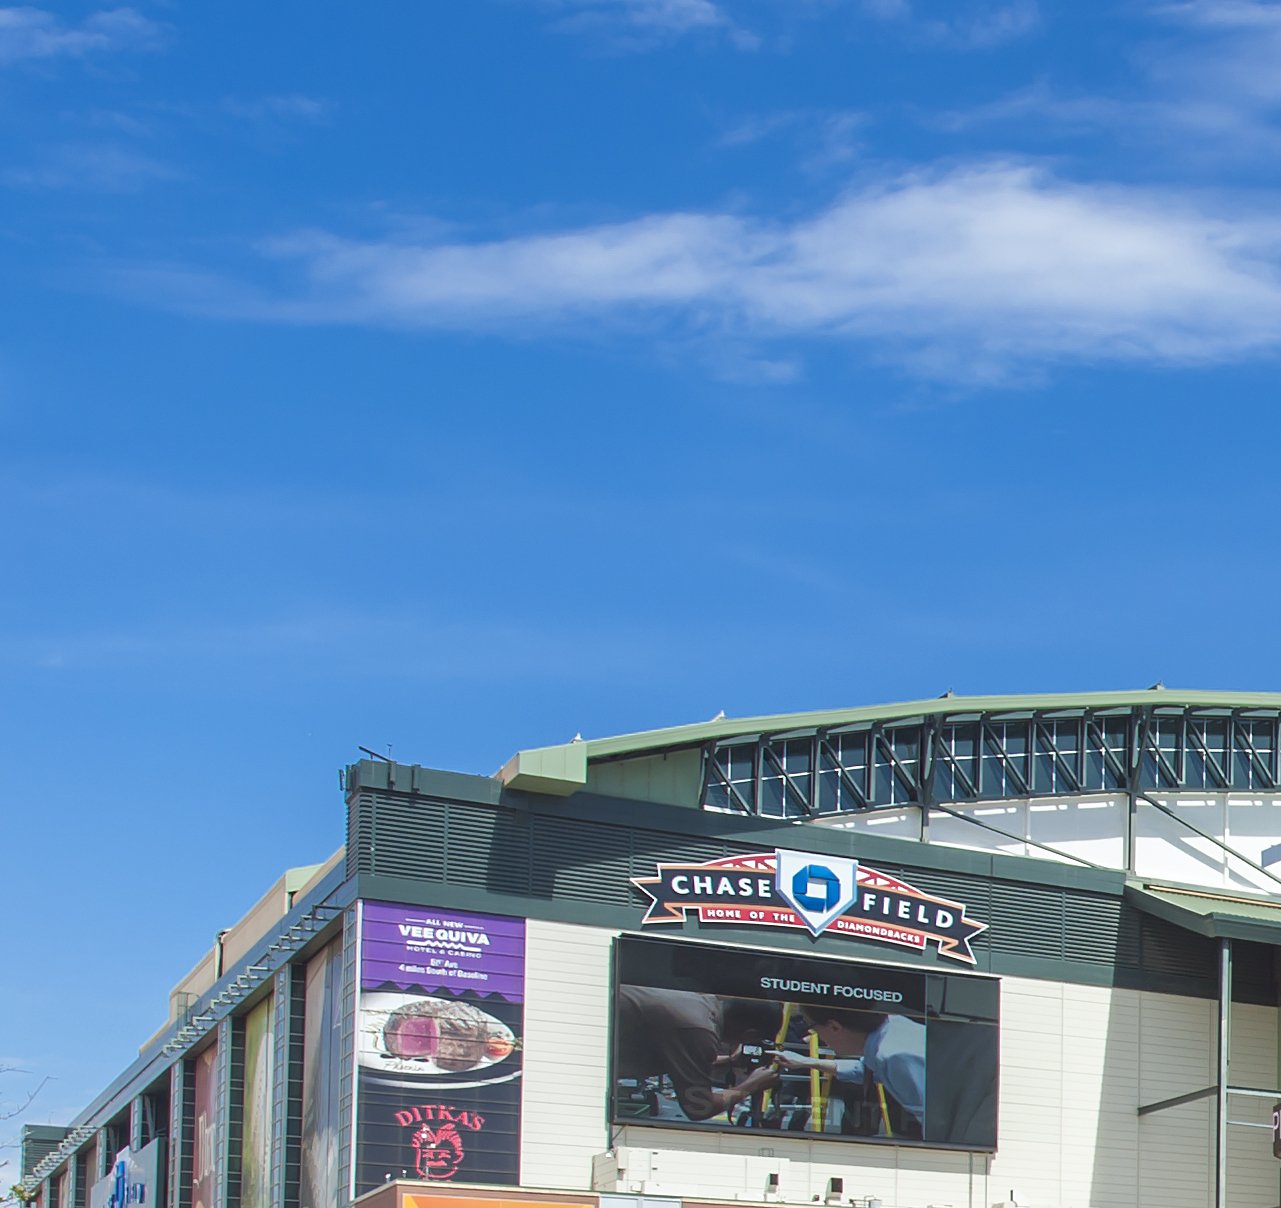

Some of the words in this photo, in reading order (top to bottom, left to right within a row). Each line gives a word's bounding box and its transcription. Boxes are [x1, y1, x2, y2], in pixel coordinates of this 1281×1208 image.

[671, 875, 772, 898] CHASE
[863, 893, 954, 929] FIELD
[425, 918, 441, 926] ALL
[442, 920, 464, 929] NEW
[707, 909, 743, 919] HOME
[750, 910, 765, 920] OF
[773, 911, 795, 923] THE
[837, 920, 921, 944] DIAMONDBACKS
[406, 945, 436, 954] HOTEL
[448, 949, 482, 959] CASINO
[760, 977, 830, 996] STUDENT
[833, 985, 903, 1003] FOCUSED
[395, 1104, 485, 1131] DITKA'S
